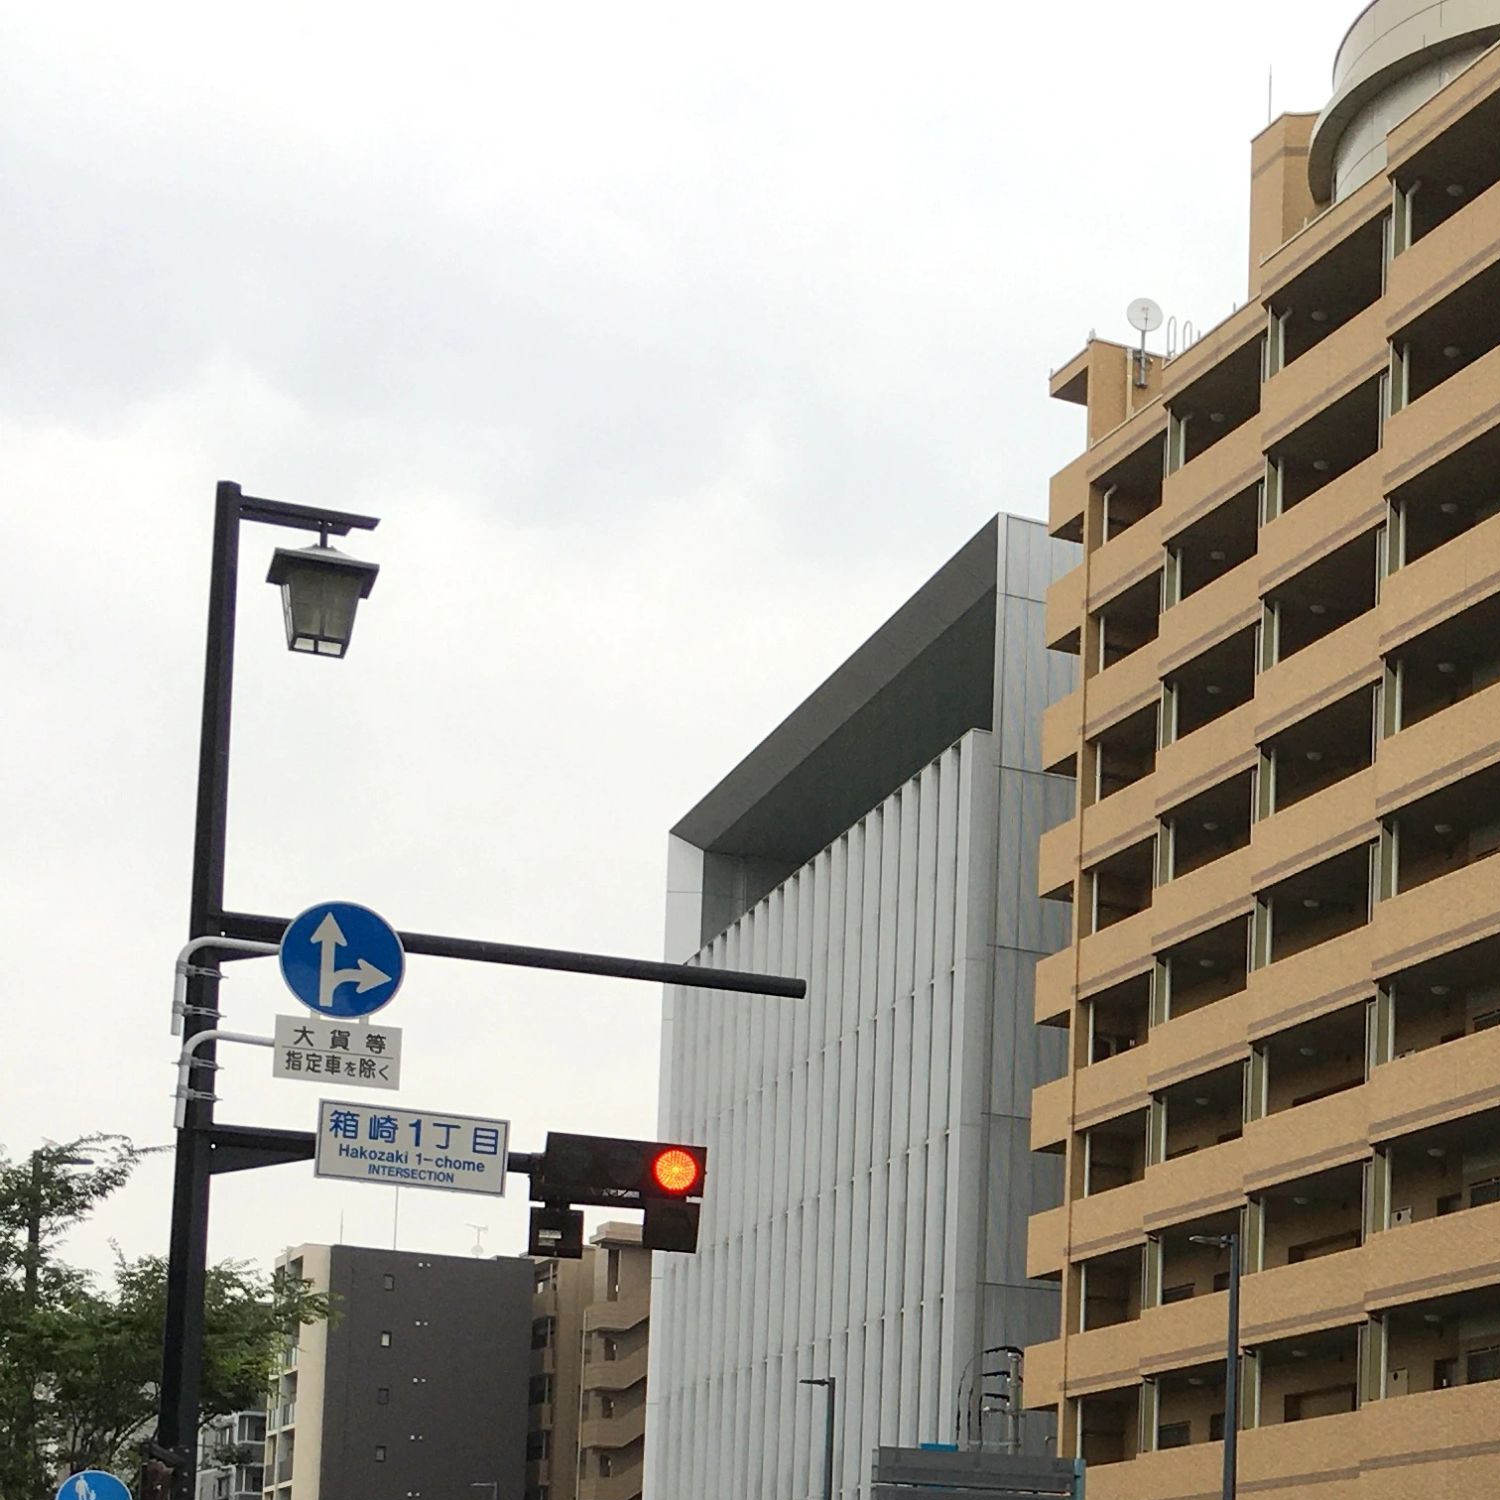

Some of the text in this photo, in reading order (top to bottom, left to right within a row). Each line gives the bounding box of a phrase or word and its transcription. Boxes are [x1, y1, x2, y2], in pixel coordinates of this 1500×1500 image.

[293, 1025, 387, 1055] 大貨等
[284, 1050, 390, 1081] 指定車を除く
[328, 1109, 500, 1157] 箱崎1丁目
[338, 1143, 486, 1173] Hakozaki 1-chome
[367, 1164, 455, 1184] INTERSECTION
